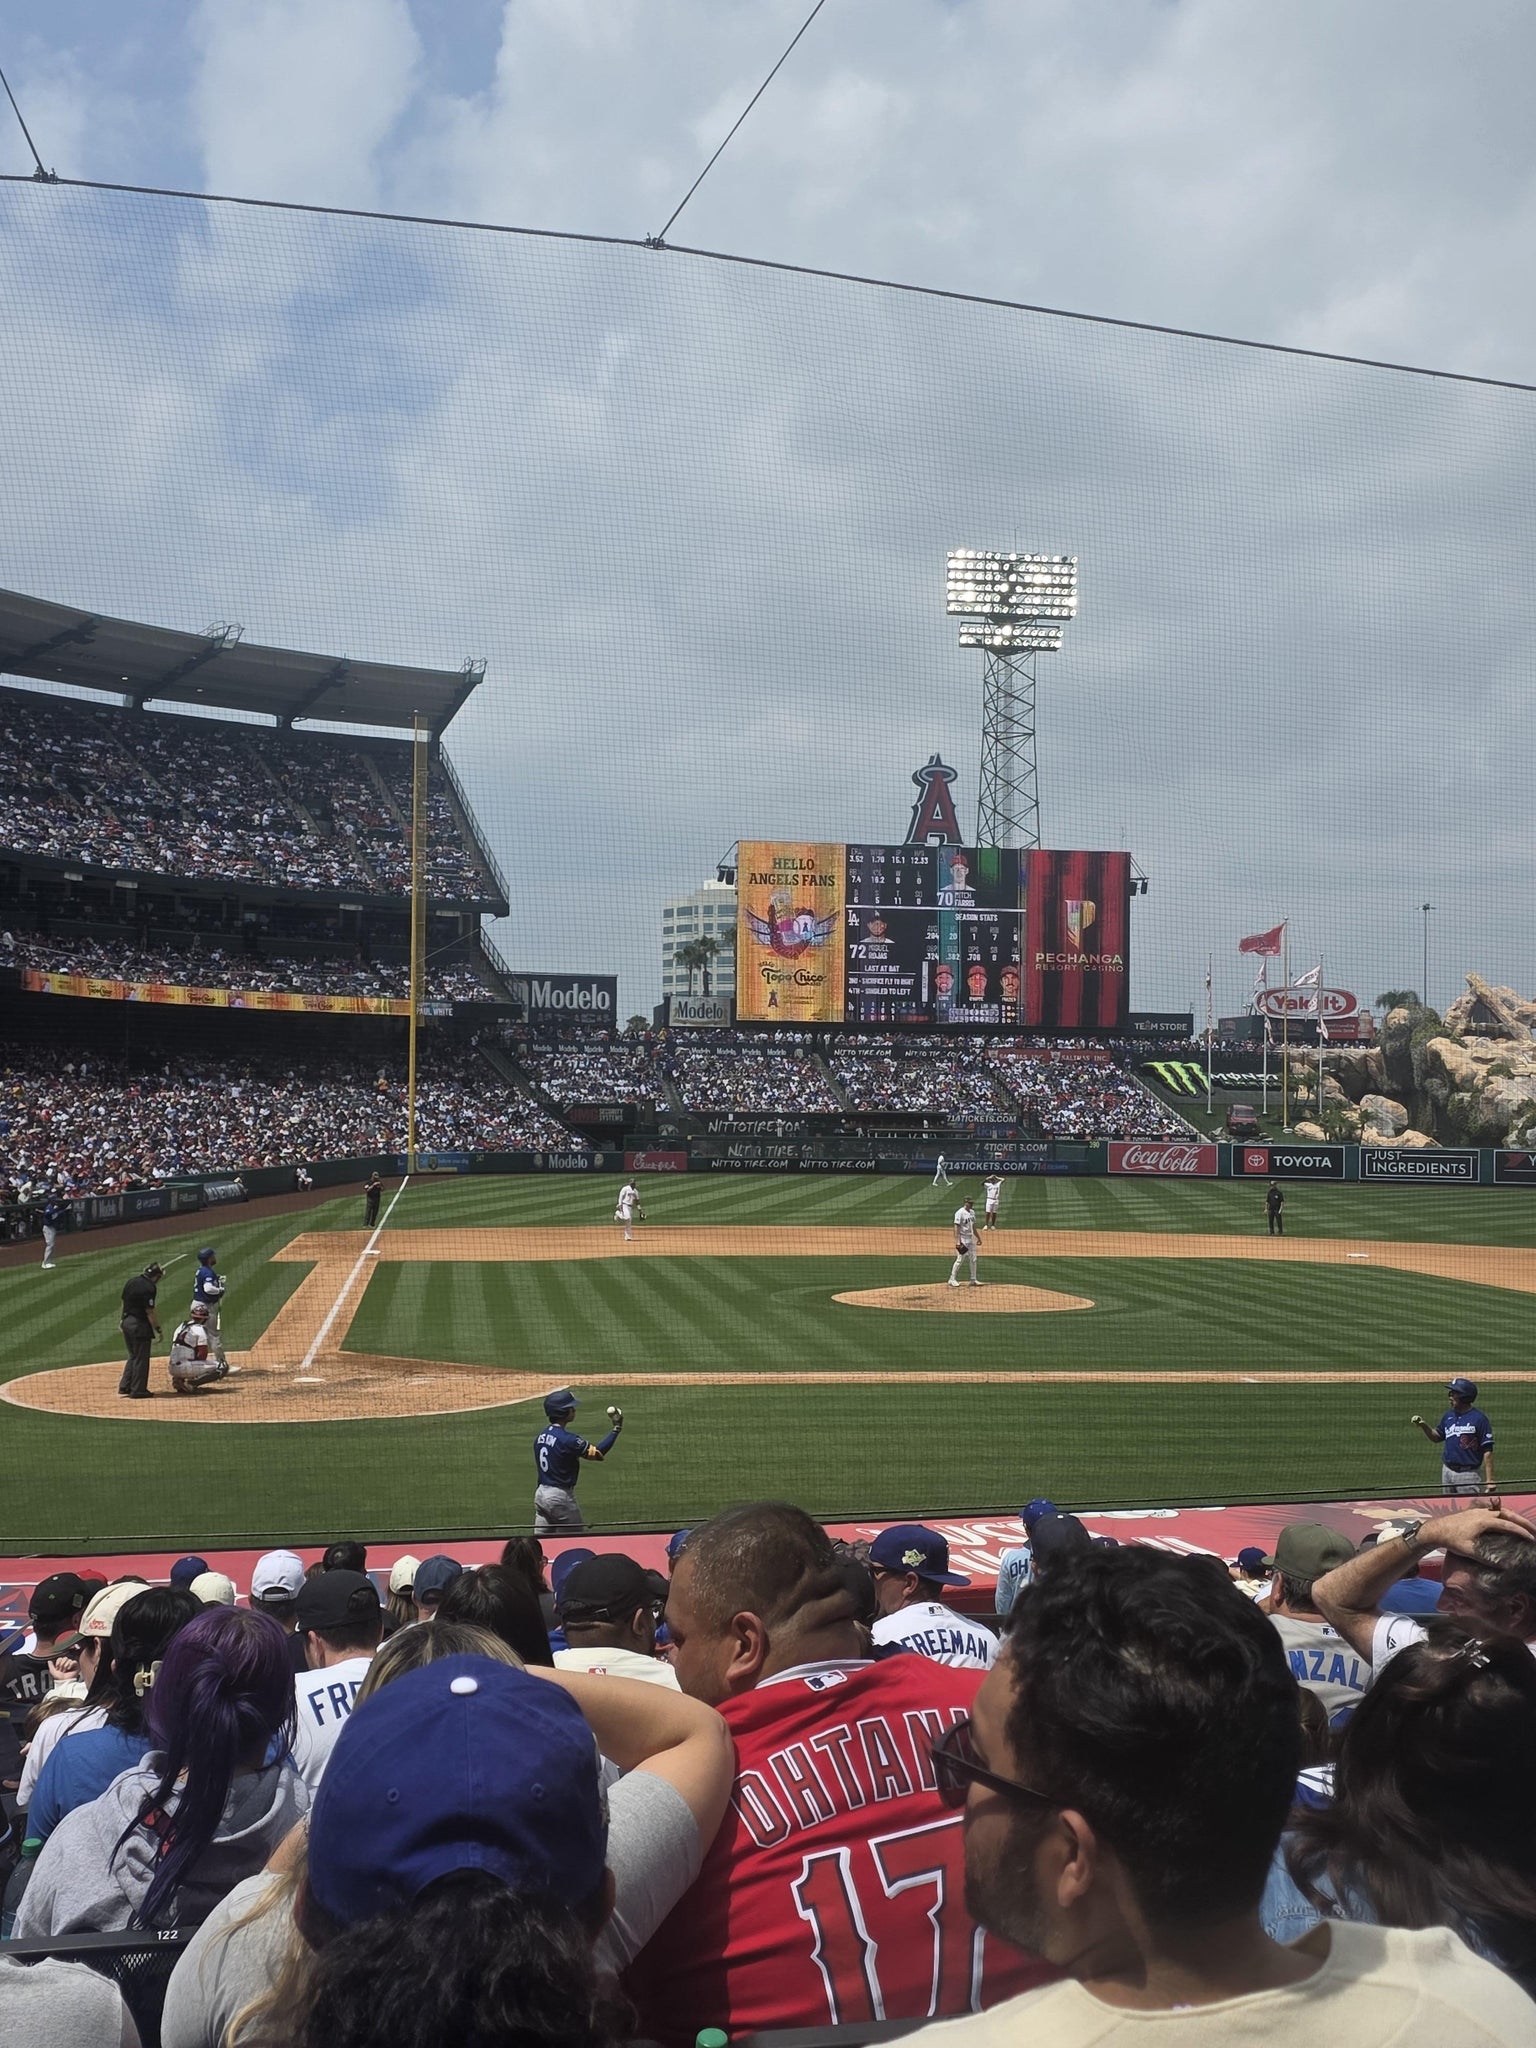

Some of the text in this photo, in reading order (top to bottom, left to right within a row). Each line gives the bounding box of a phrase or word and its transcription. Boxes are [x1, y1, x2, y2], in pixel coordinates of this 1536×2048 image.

[773, 858, 815, 870] HELLO
[749, 873, 835, 887] ANGELS FANS
[937, 892, 953, 906] 70
[849, 944, 866, 959] 72
[1035, 953, 1123, 965] PECHANGA
[531, 980, 611, 1010] Modelo
[1273, 995, 1343, 1011] Yaklt
[434, 1008, 454, 1017] WHITE
[678, 1001, 723, 1020] Modelo
[1159, 1022, 1188, 1031] STORE
[548, 1154, 588, 1169] Modelo
[1273, 1156, 1333, 1168] TOYOTA
[1371, 1150, 1403, 1161] JUST
[712, 1159, 741, 1169] NITTO
[800, 1159, 828, 1169] NITTO
[1372, 1161, 1467, 1175] INGREDIENTS
[539, 1446, 549, 1473] 6
[1009, 1560, 1033, 1579] OH
[900, 1628, 988, 1663] FREEMAN
[790, 1815, 987, 2026] 17
[157, 1930, 178, 1941] 122
